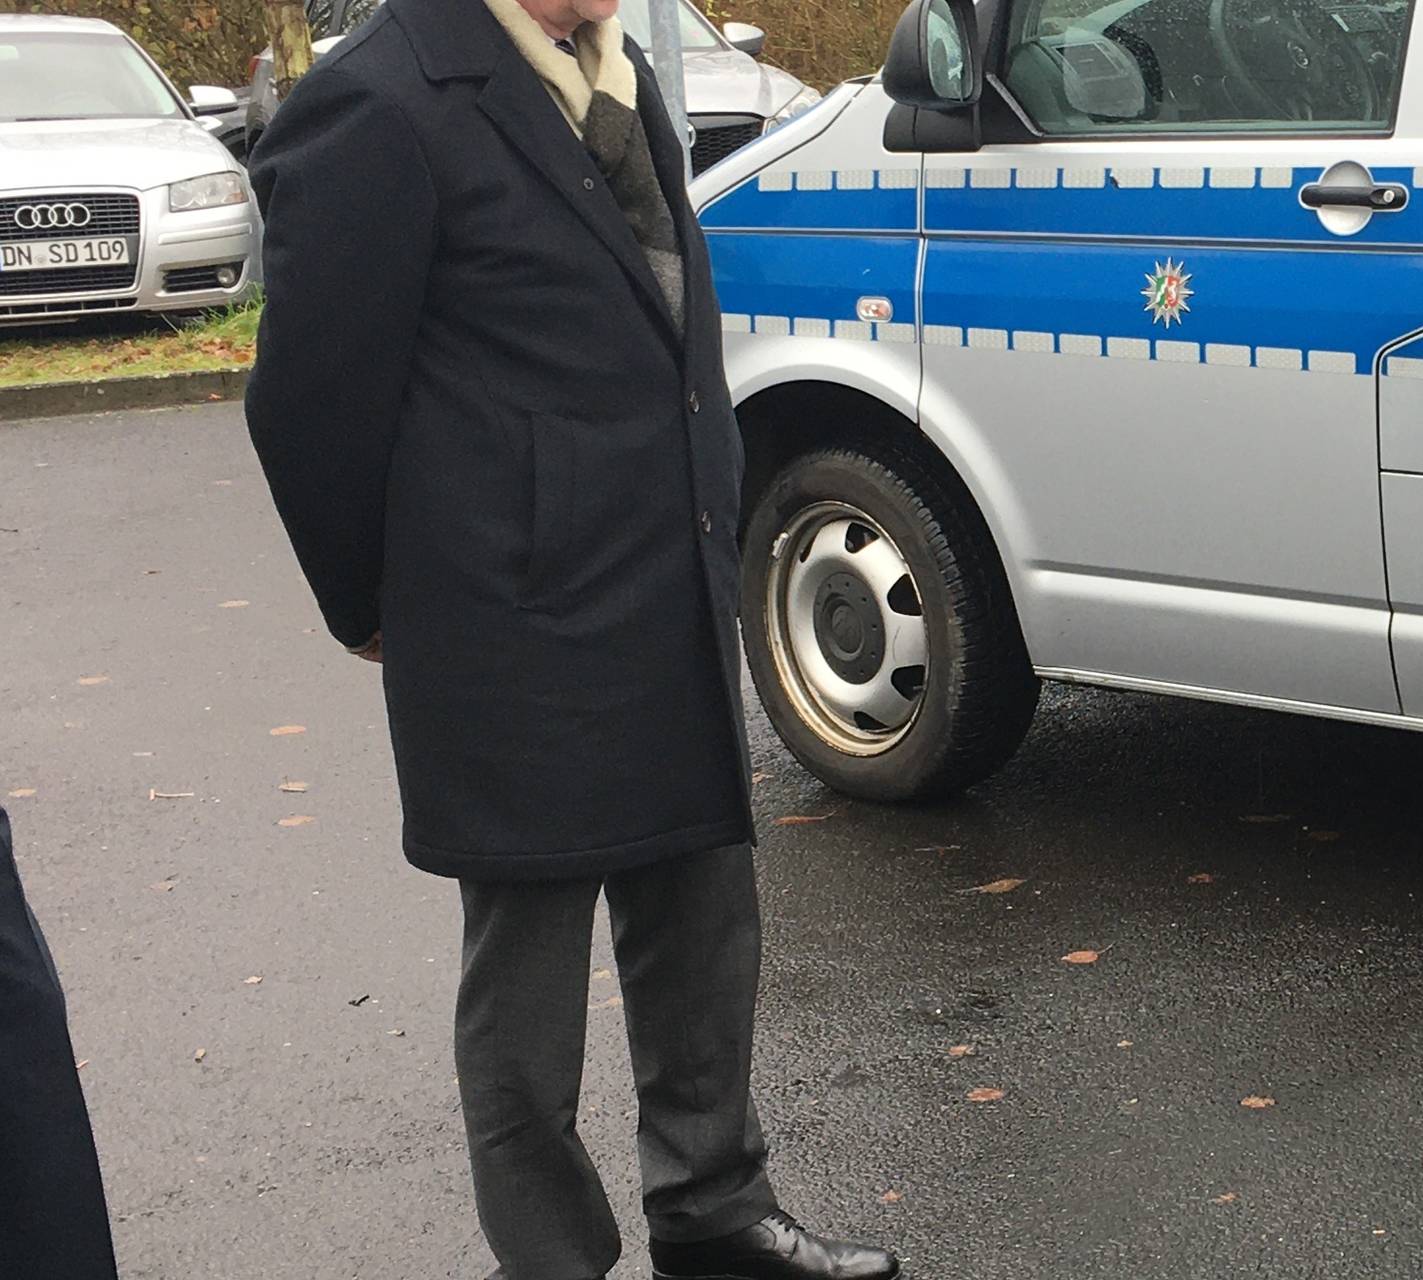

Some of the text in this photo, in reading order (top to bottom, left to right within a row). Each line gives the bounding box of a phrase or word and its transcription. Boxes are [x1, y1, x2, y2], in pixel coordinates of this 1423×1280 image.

[2, 240, 125, 266] DN SD 109
